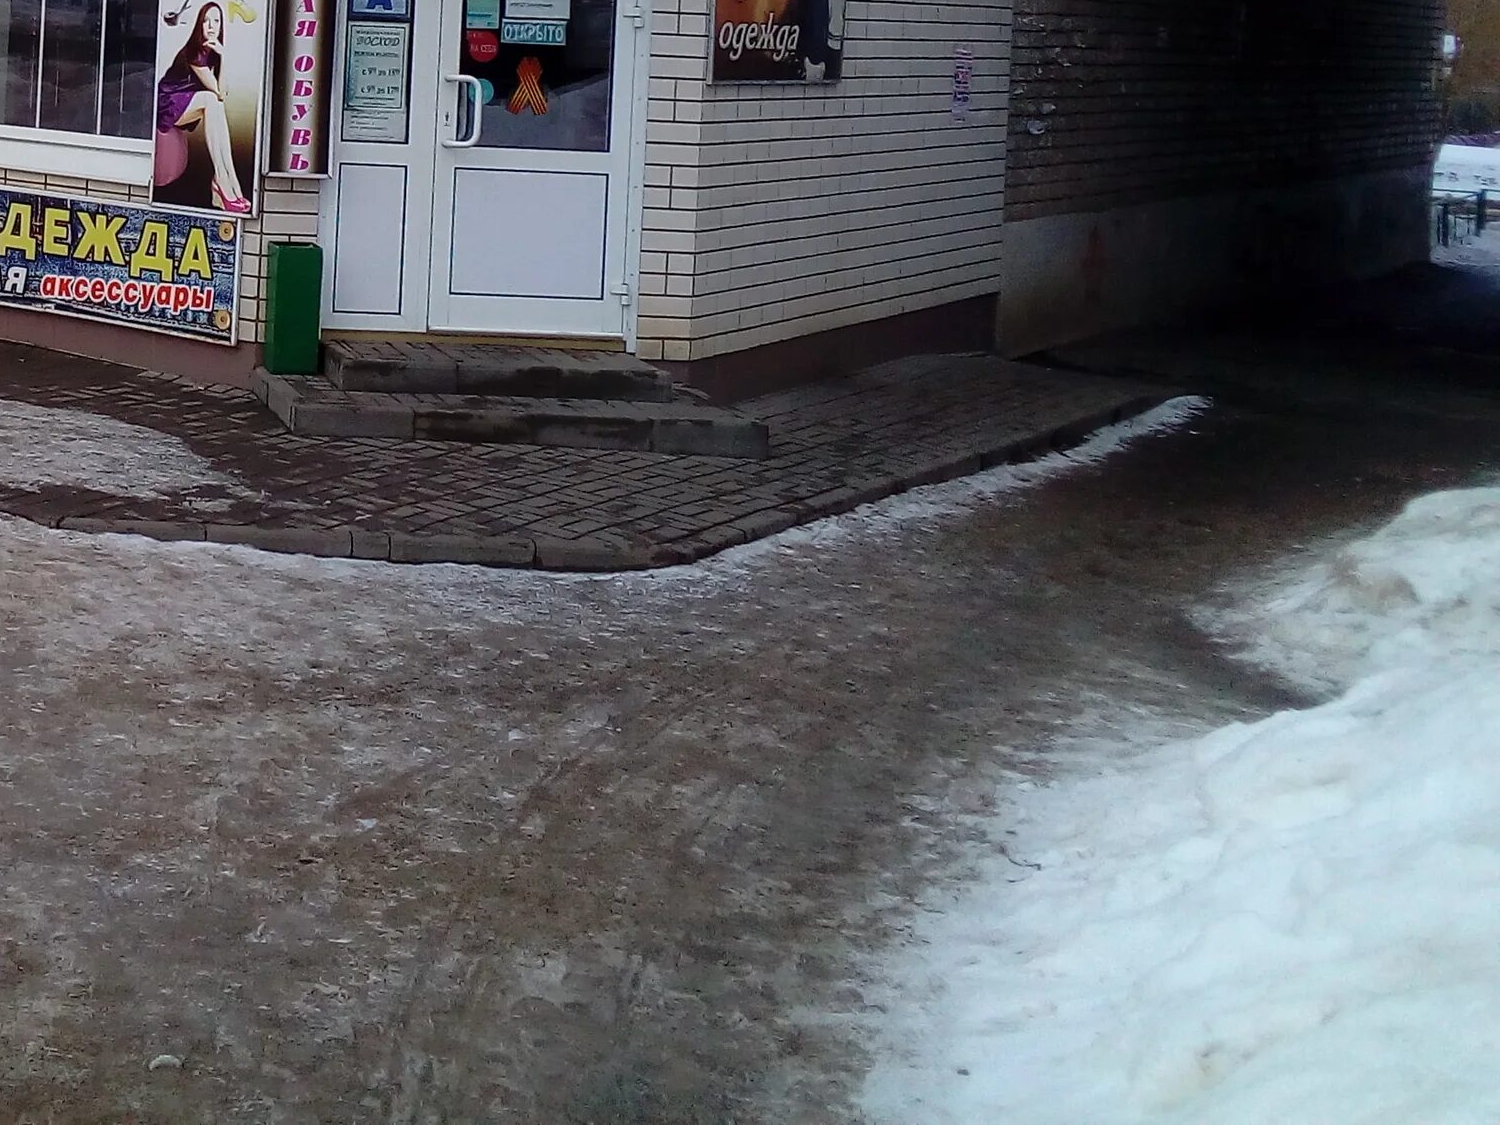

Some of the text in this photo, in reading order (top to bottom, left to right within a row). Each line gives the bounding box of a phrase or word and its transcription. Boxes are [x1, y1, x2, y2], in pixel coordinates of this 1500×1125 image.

[503, 24, 564, 42] ОТКРЫТО
[718, 12, 801, 62] одежда
[288, 53, 317, 172] ОБУВЬ
[38, 272, 215, 315] аксессуары
